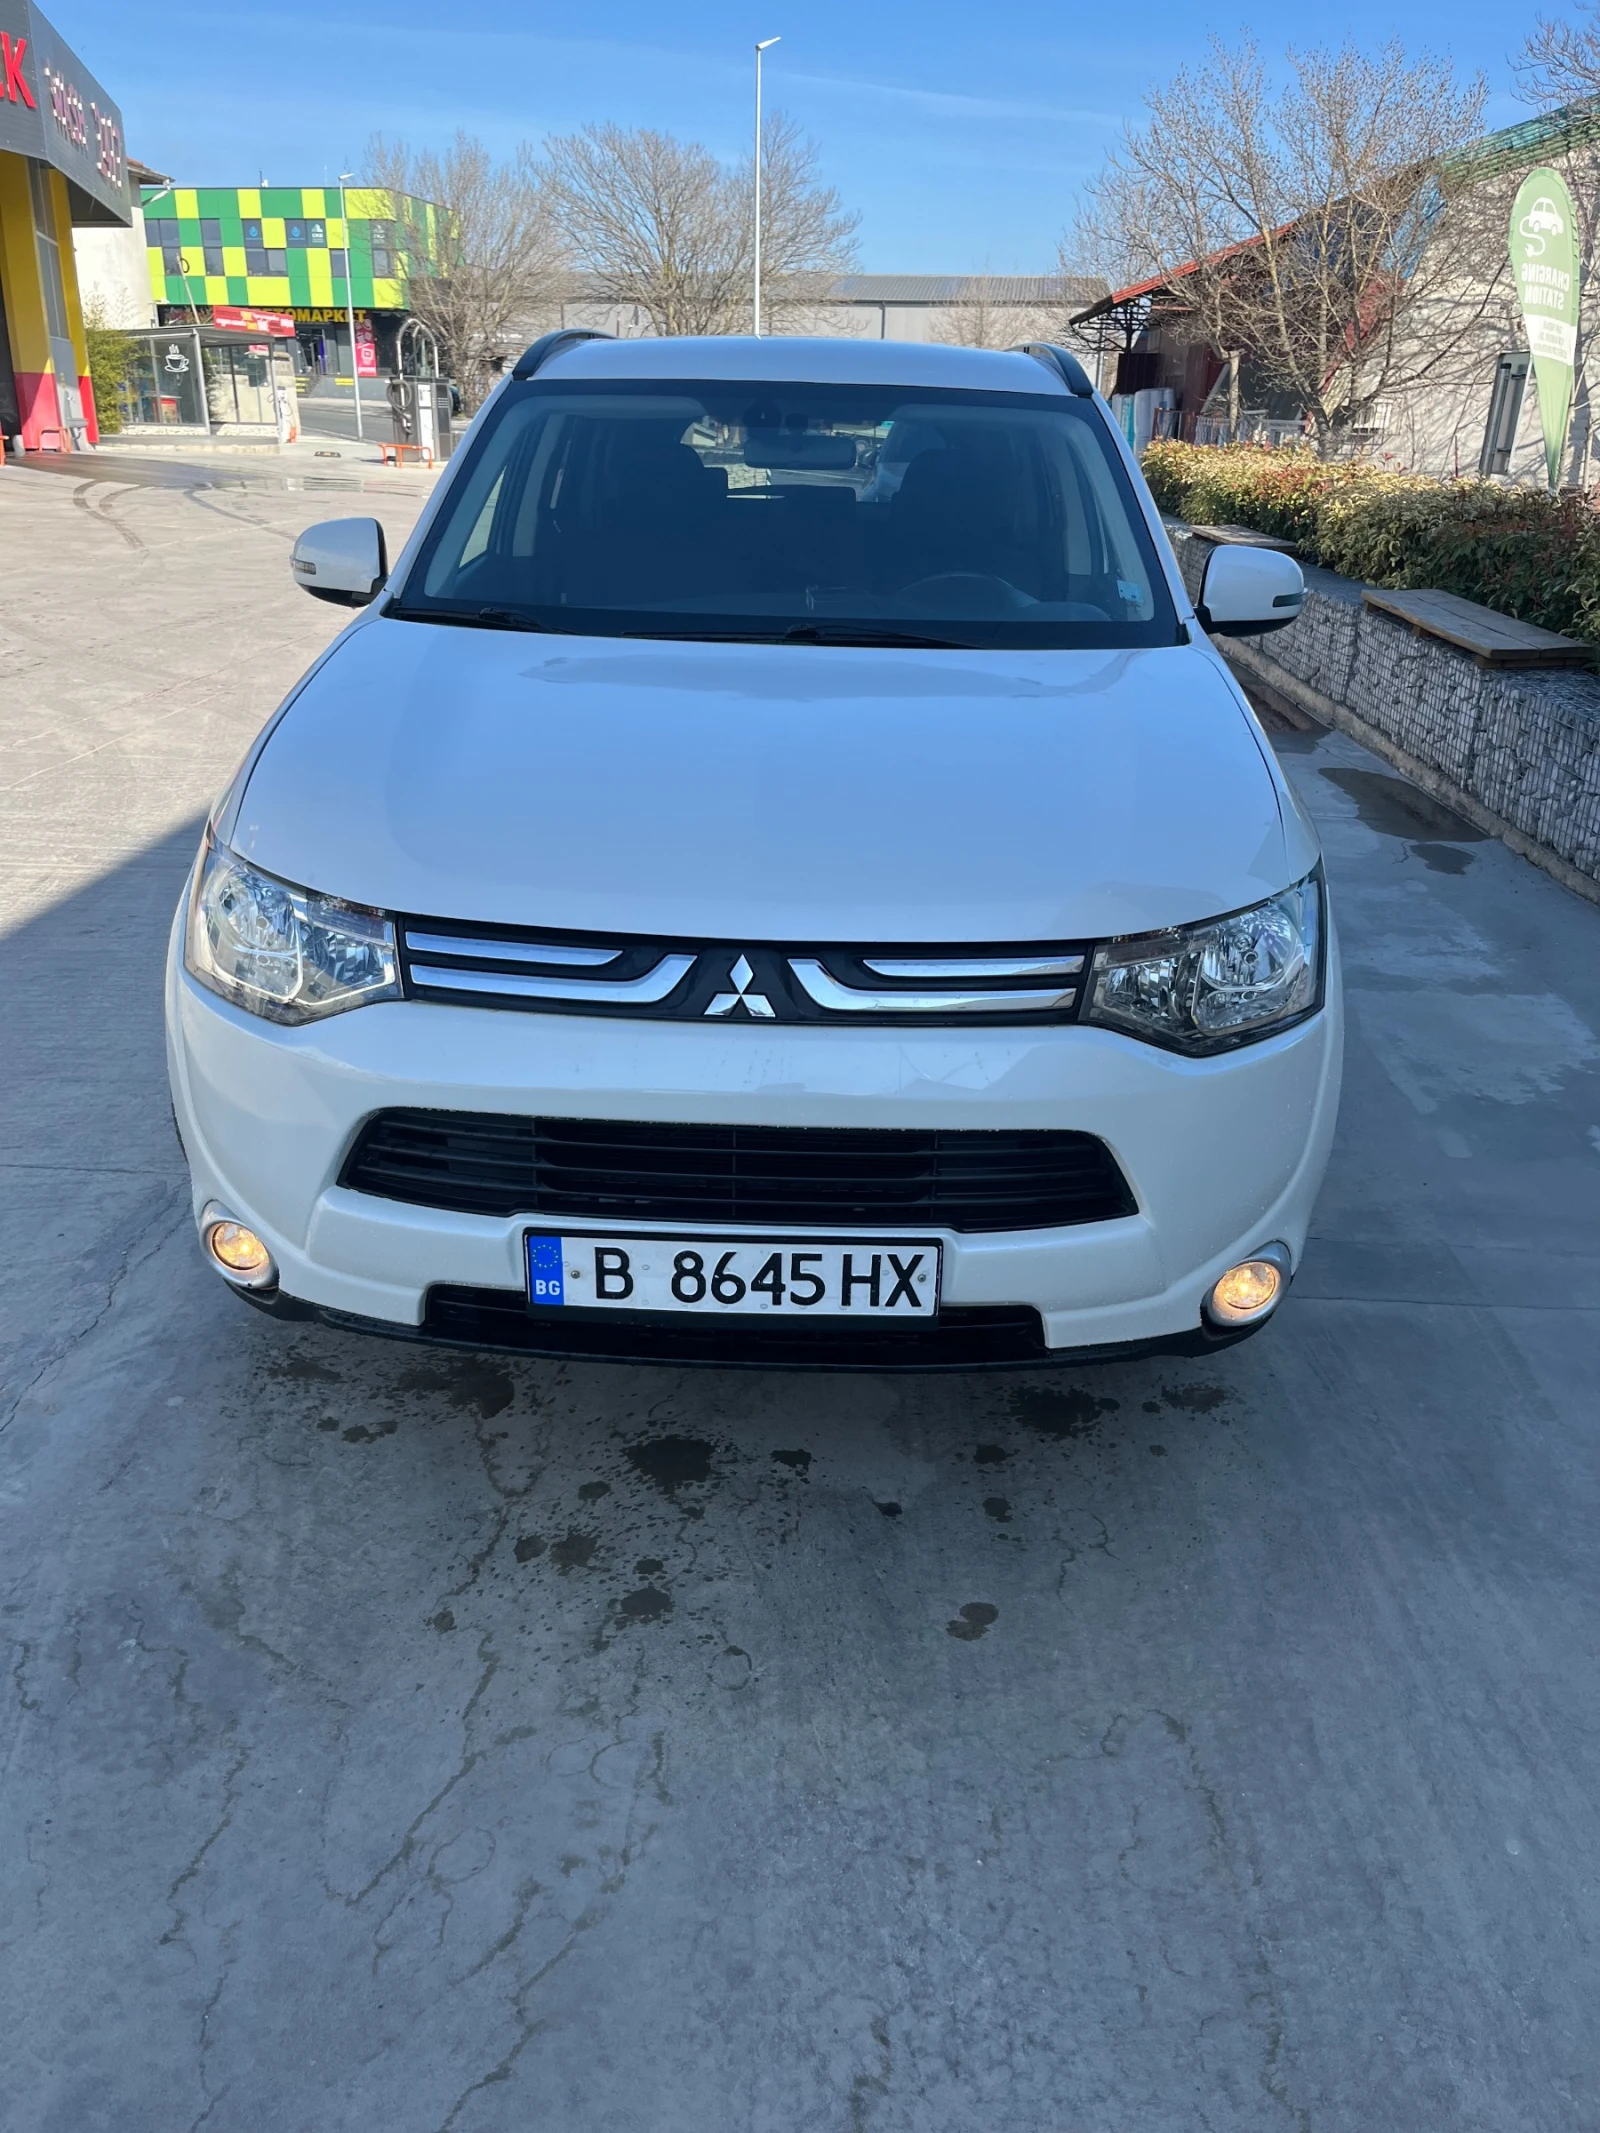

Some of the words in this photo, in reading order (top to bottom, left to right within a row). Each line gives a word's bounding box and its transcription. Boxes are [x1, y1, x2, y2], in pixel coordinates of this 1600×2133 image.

[535, 1279, 561, 1296] BG
[594, 1246, 634, 1300] B
[671, 1250, 826, 1306] 8645
[841, 1253, 925, 1307] HX
